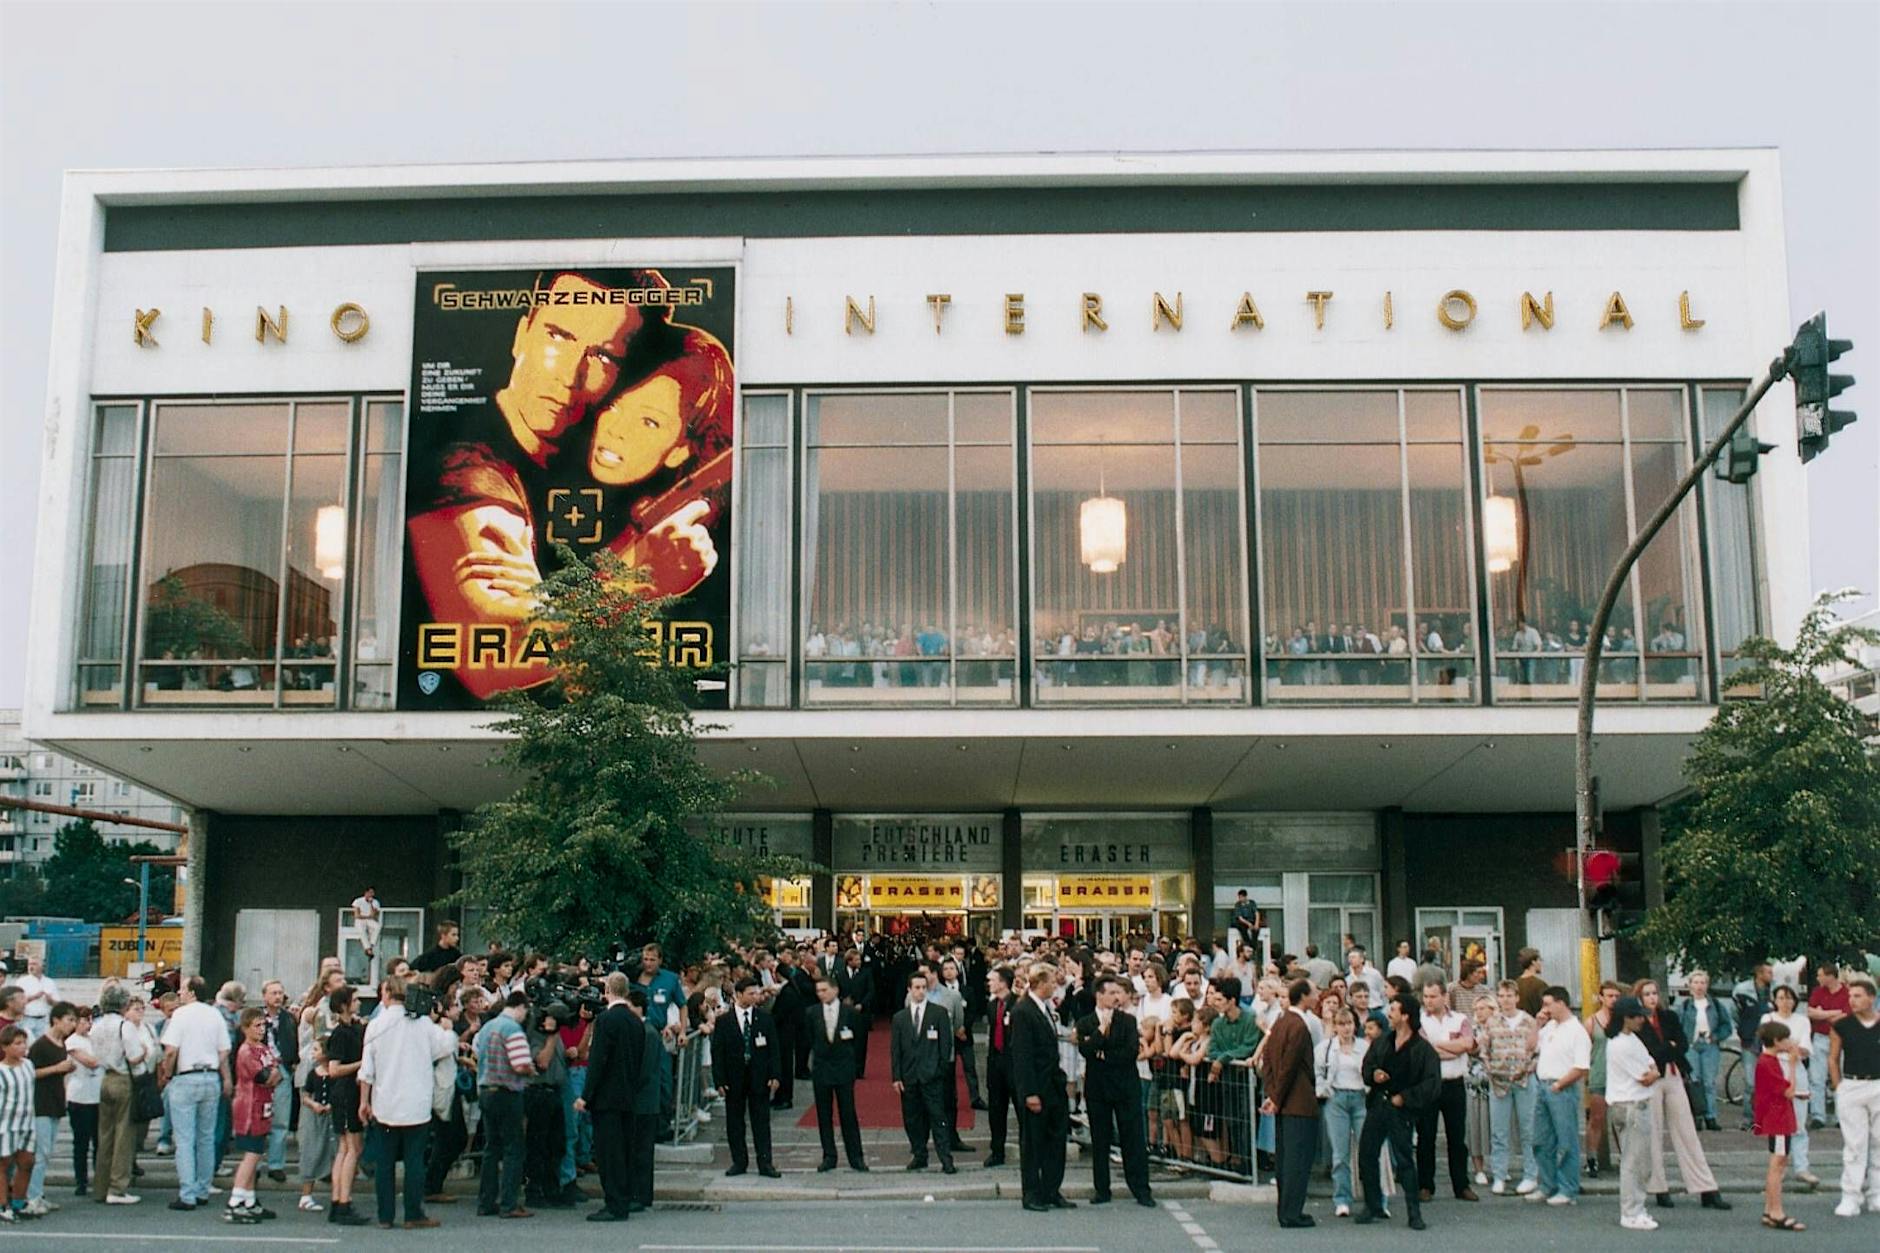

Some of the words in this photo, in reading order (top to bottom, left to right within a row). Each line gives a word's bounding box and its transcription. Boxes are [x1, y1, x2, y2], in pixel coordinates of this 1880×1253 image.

[440, 287, 704, 310] SCHWARZENEGGER
[134, 302, 370, 348] KINO
[786, 289, 1706, 335] INTERNATIONAL
[417, 622, 713, 669] ERAR
[709, 827, 768, 845] EUTE
[862, 826, 989, 844] EUTSCHLAND
[863, 845, 968, 862] PREMIERE
[1060, 845, 1150, 863] ERASER
[873, 886, 960, 896] ERASER
[1061, 886, 1150, 896] ERASER
